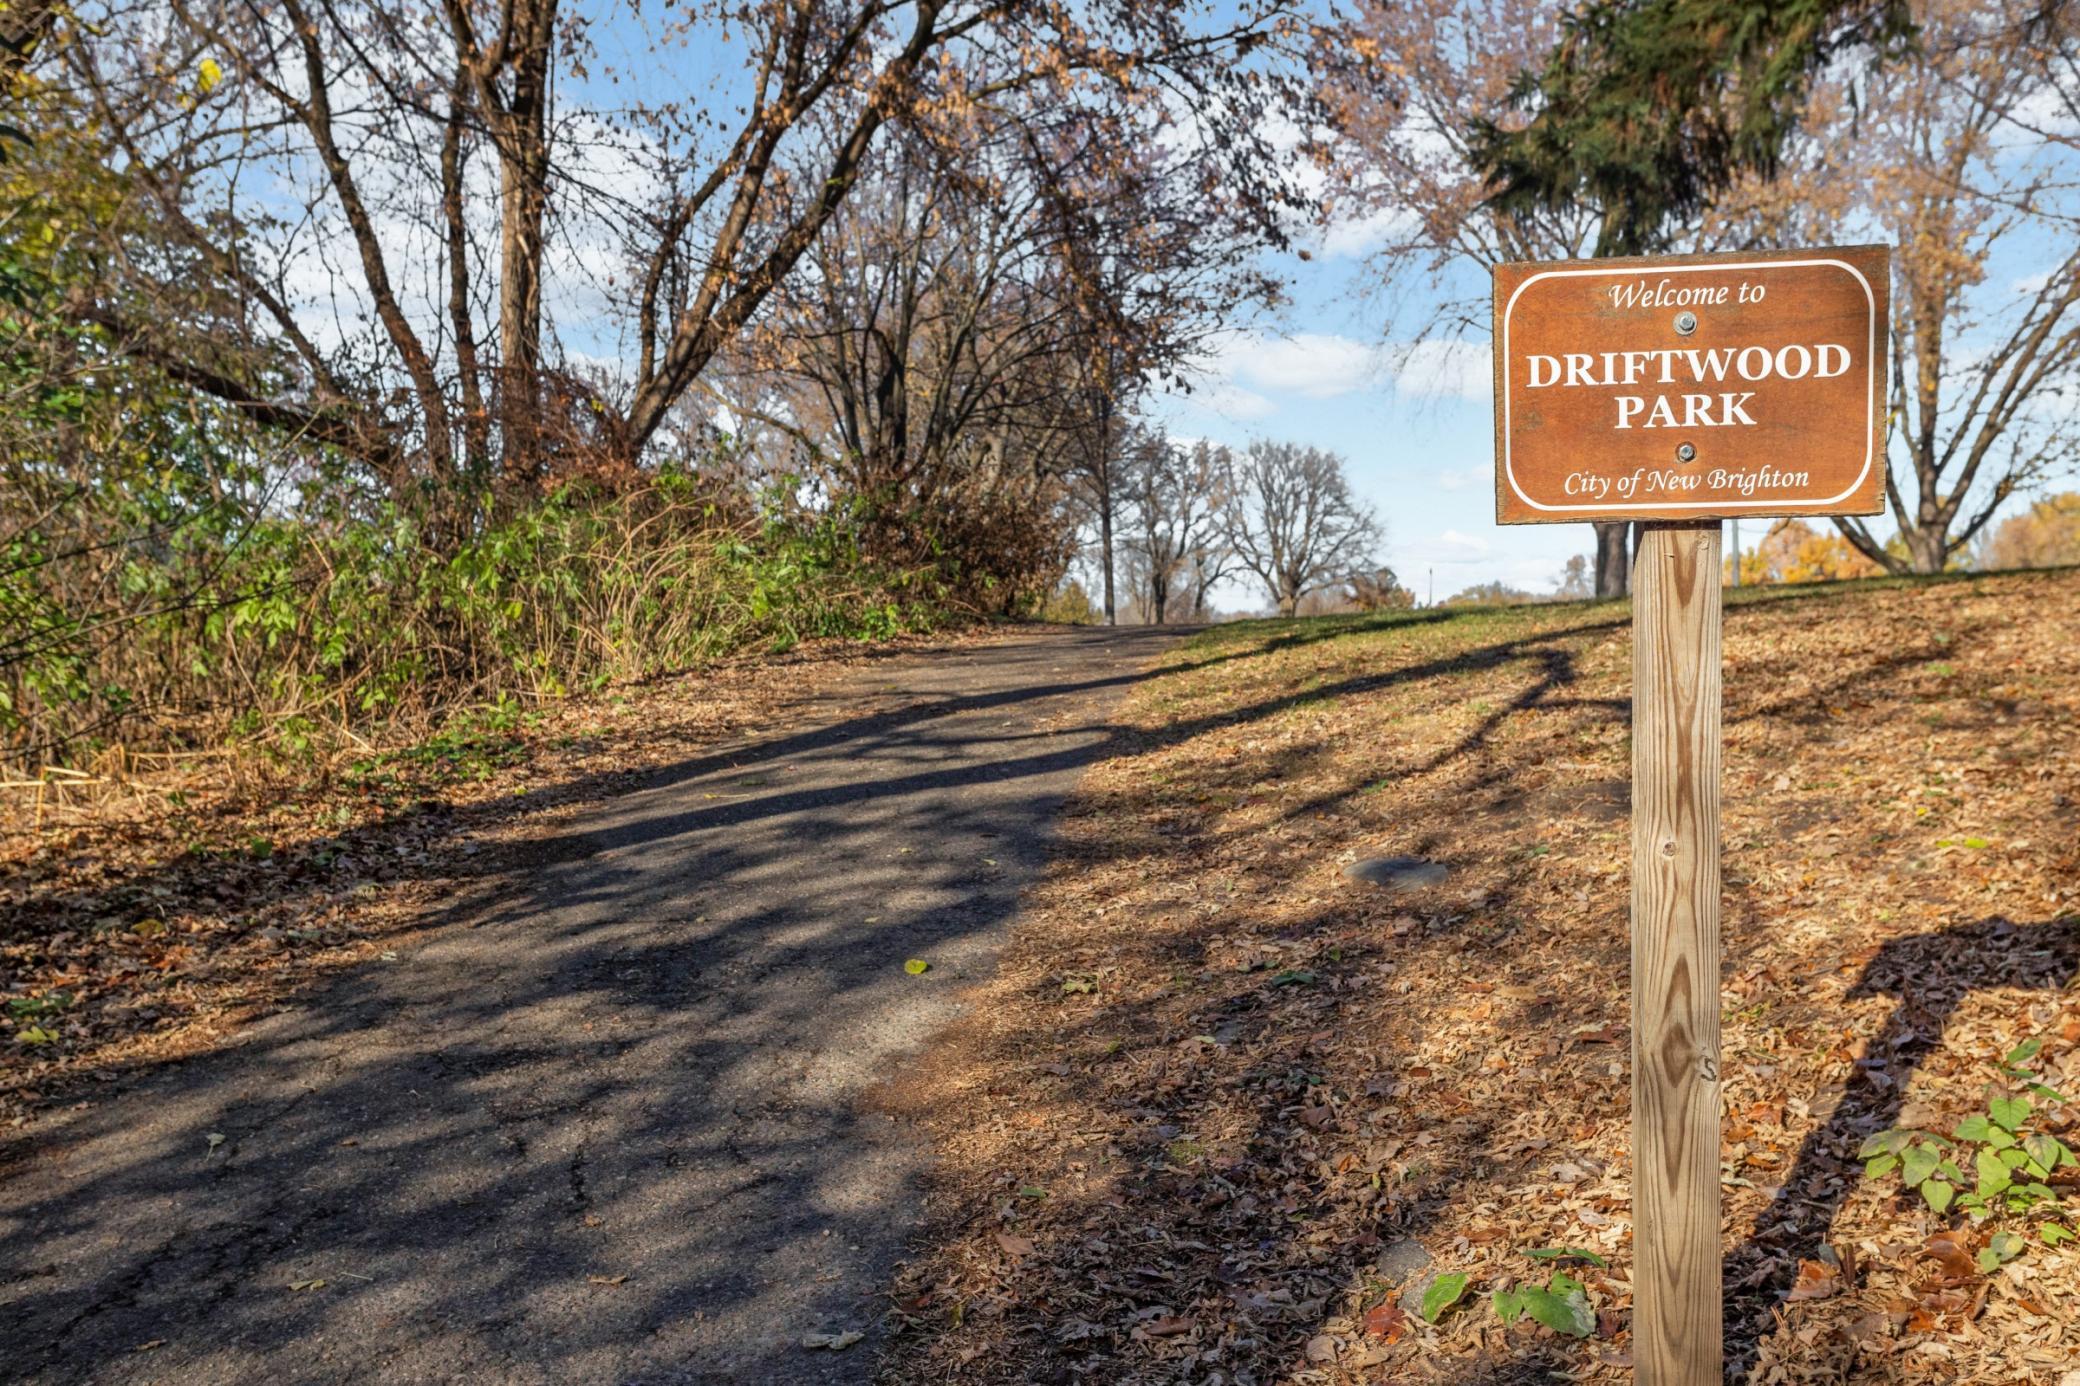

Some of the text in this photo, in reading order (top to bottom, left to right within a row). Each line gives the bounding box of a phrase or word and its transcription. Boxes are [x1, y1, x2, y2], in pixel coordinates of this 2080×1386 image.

[1609, 278, 1766, 309] Welcome to
[1526, 344, 1852, 388] DRIFTWOOD
[1614, 392, 1757, 429] PARK
[1564, 464, 1809, 499] City of New Brighton
